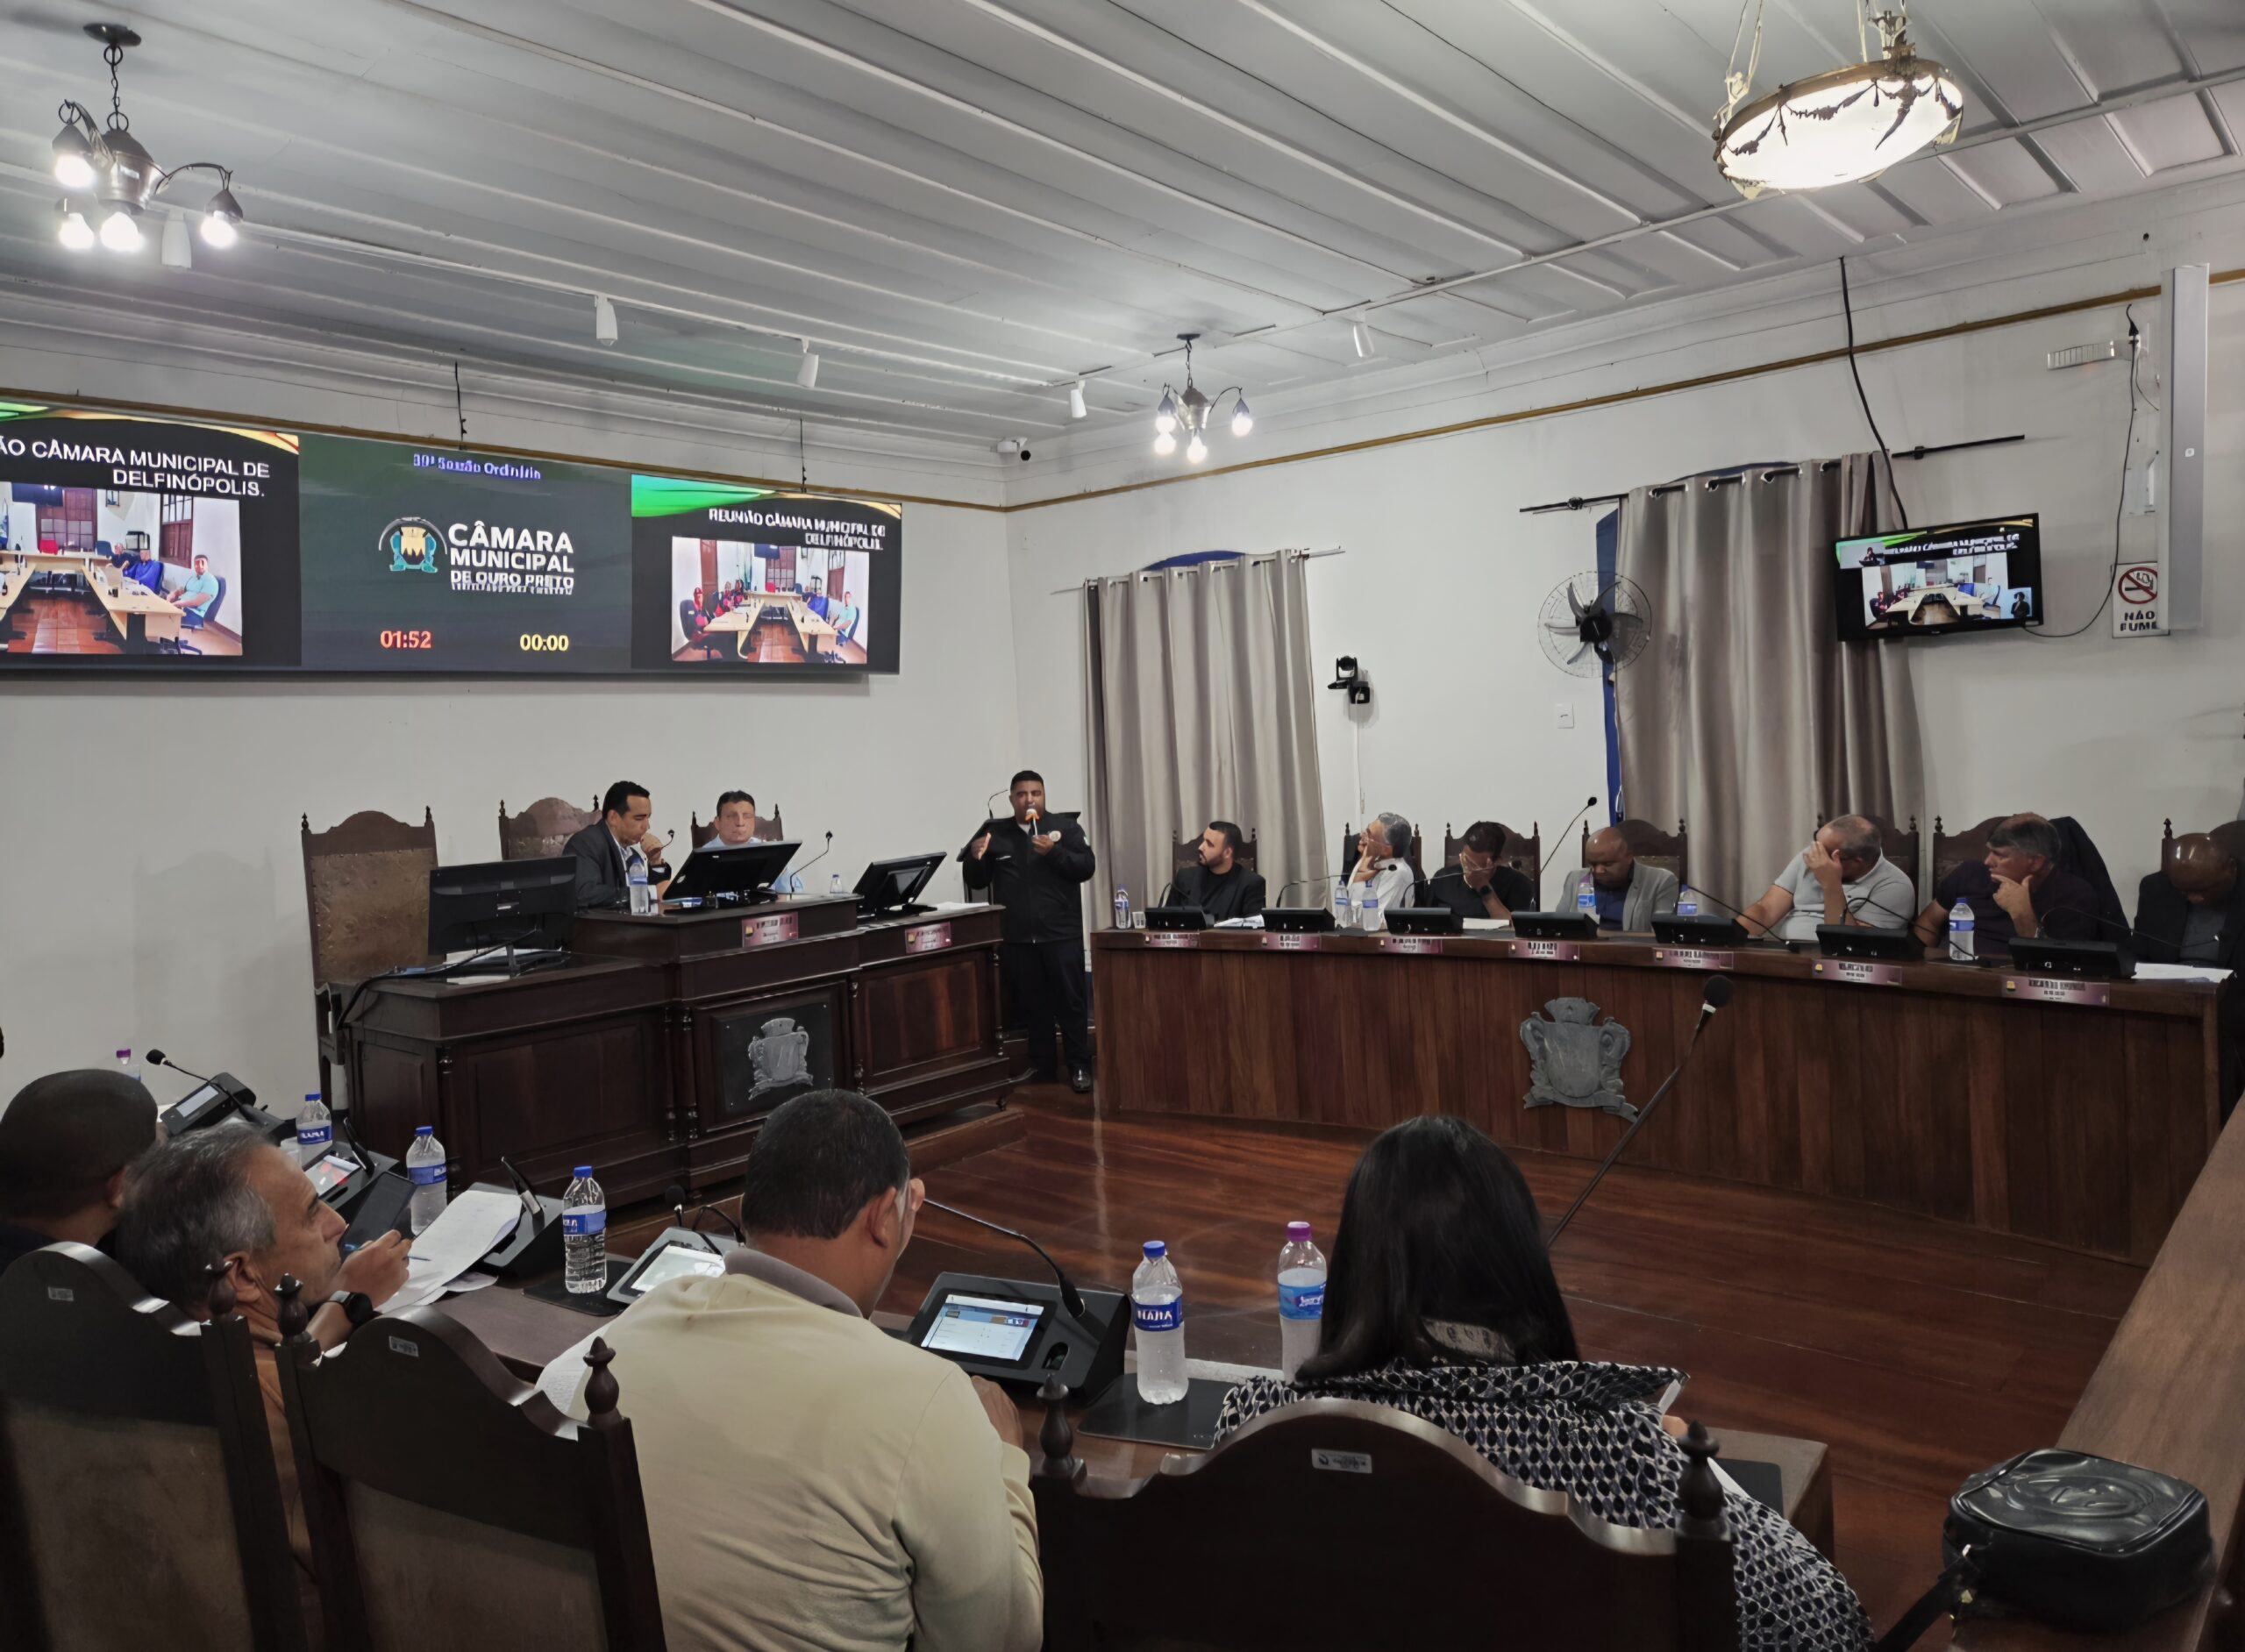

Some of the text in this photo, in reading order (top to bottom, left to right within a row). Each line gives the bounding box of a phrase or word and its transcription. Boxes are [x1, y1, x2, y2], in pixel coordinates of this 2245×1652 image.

[32, 439, 125, 466] CÂMARA
[131, 450, 239, 476] MUNICIPAL
[244, 462, 269, 478] DE
[113, 469, 265, 496] DELFINÓPOLIS.
[448, 520, 574, 554] CÂMARA
[450, 547, 574, 573] MUNICIPAL
[380, 630, 431, 649] 01:52
[519, 634, 569, 652] 00:00
